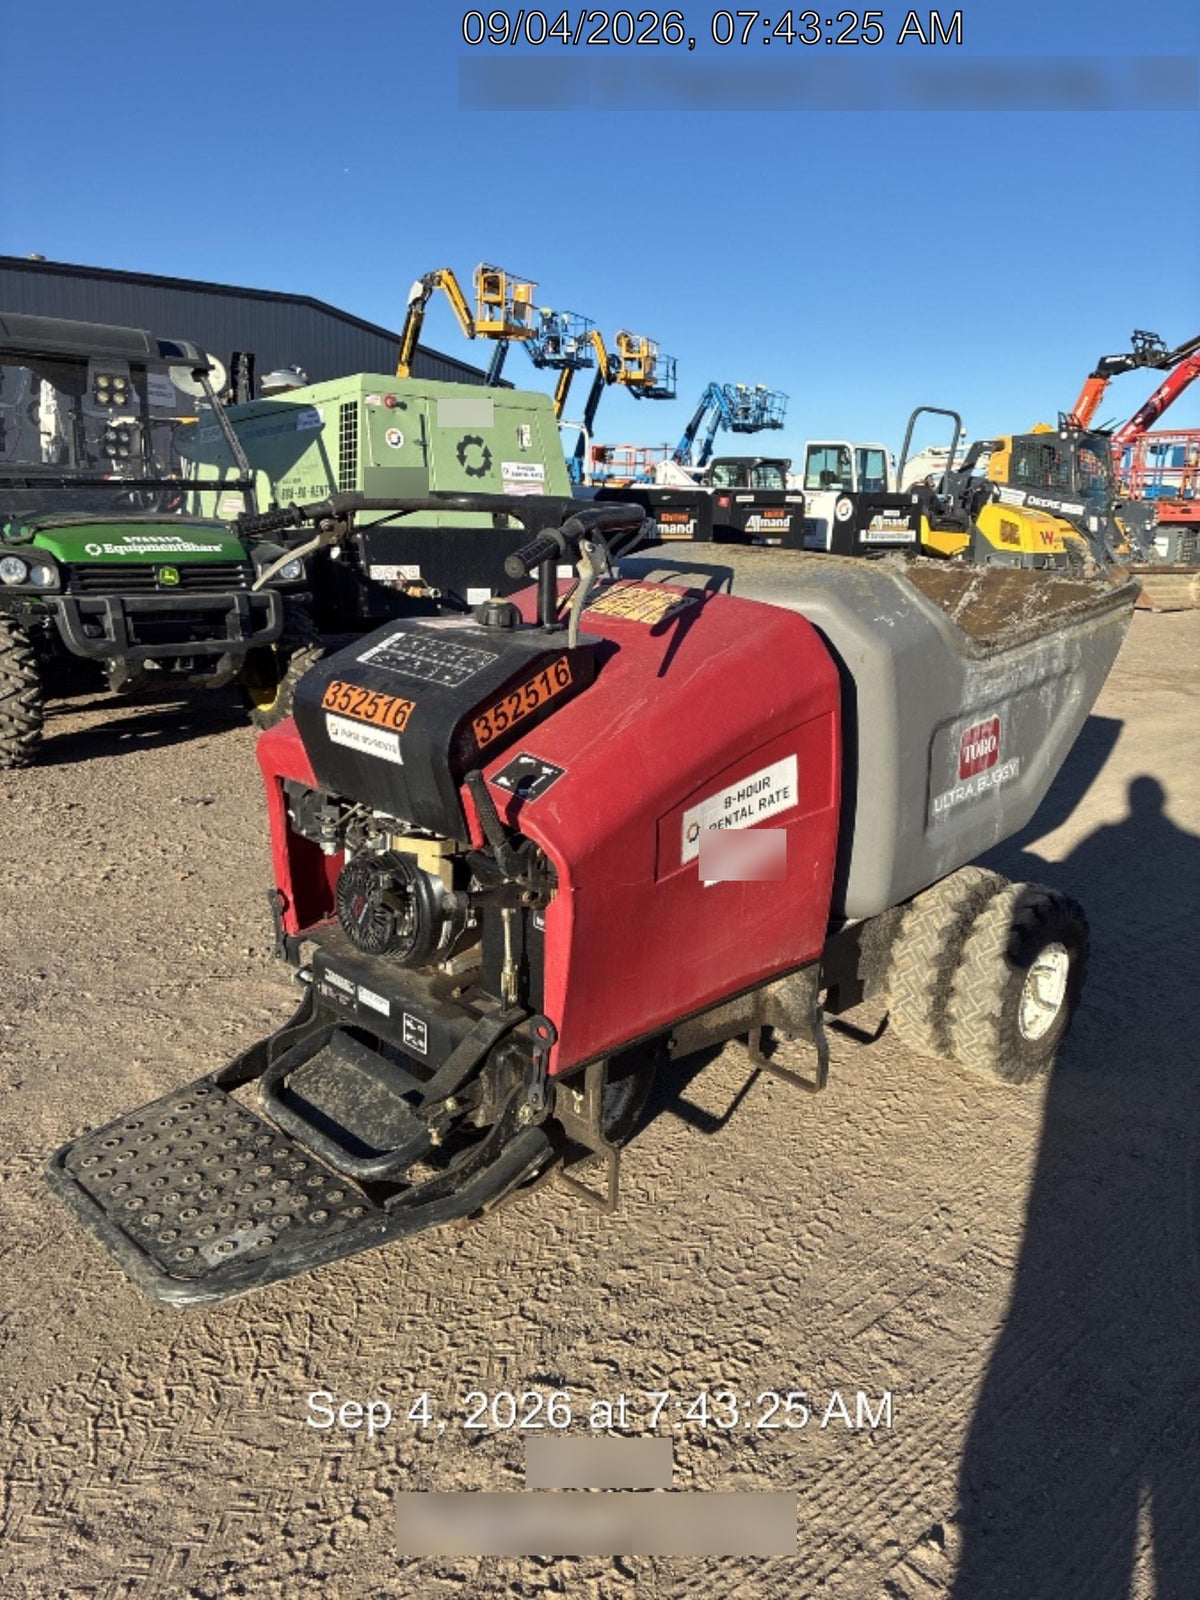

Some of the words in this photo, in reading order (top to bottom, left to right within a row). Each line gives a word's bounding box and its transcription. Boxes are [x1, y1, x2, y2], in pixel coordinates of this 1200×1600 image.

[745, 515, 794, 533] Allmand
[325, 682, 411, 727] 352516
[476, 659, 570, 745] 352516
[963, 735, 997, 764] TORO
[724, 775, 771, 810] 8-HOUR
[759, 786, 791, 811] RATE
[934, 783, 974, 813] ULTRA
[978, 760, 1016, 790] BUGGY
